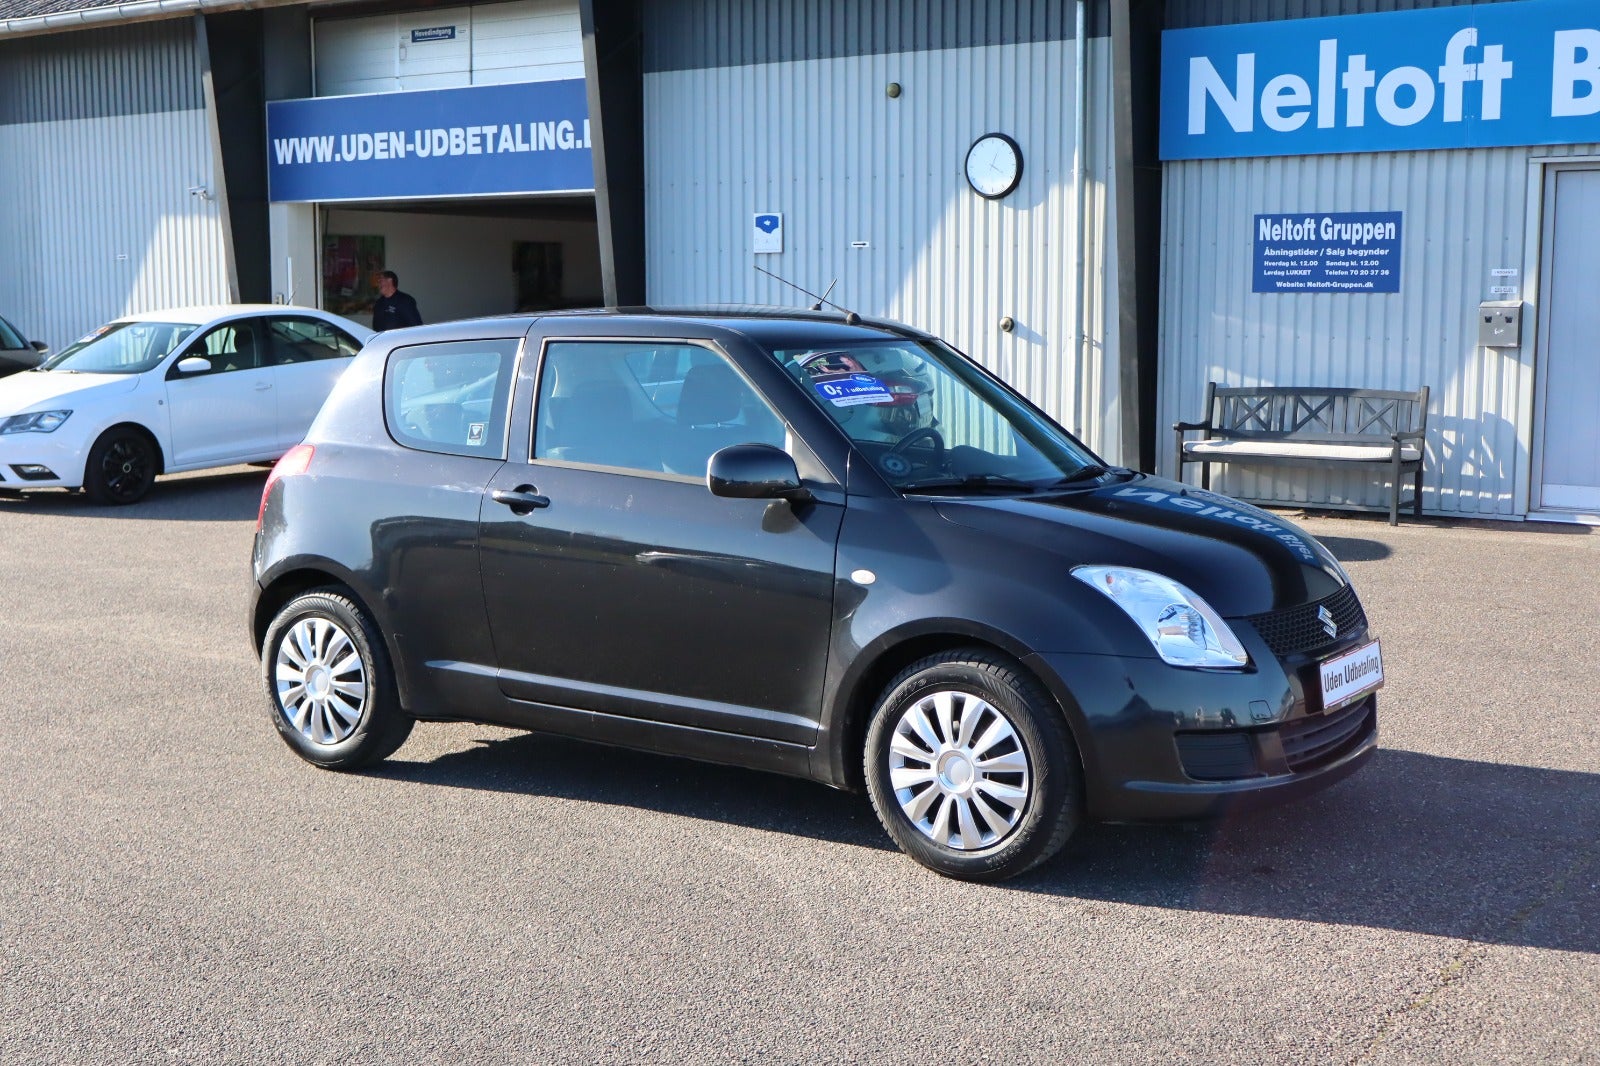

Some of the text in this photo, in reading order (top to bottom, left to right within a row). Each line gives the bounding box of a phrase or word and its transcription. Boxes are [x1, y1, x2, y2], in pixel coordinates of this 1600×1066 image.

[1188, 27, 1513, 135] Neltoft
[1259, 217, 1396, 245] Neltoft Gruppen
[1264, 247, 1318, 256] Åbningstider
[1326, 248, 1345, 256] Salg
[1347, 248, 1389, 256] begynder
[1324, 655, 1379, 693] Uden Udbetaling
